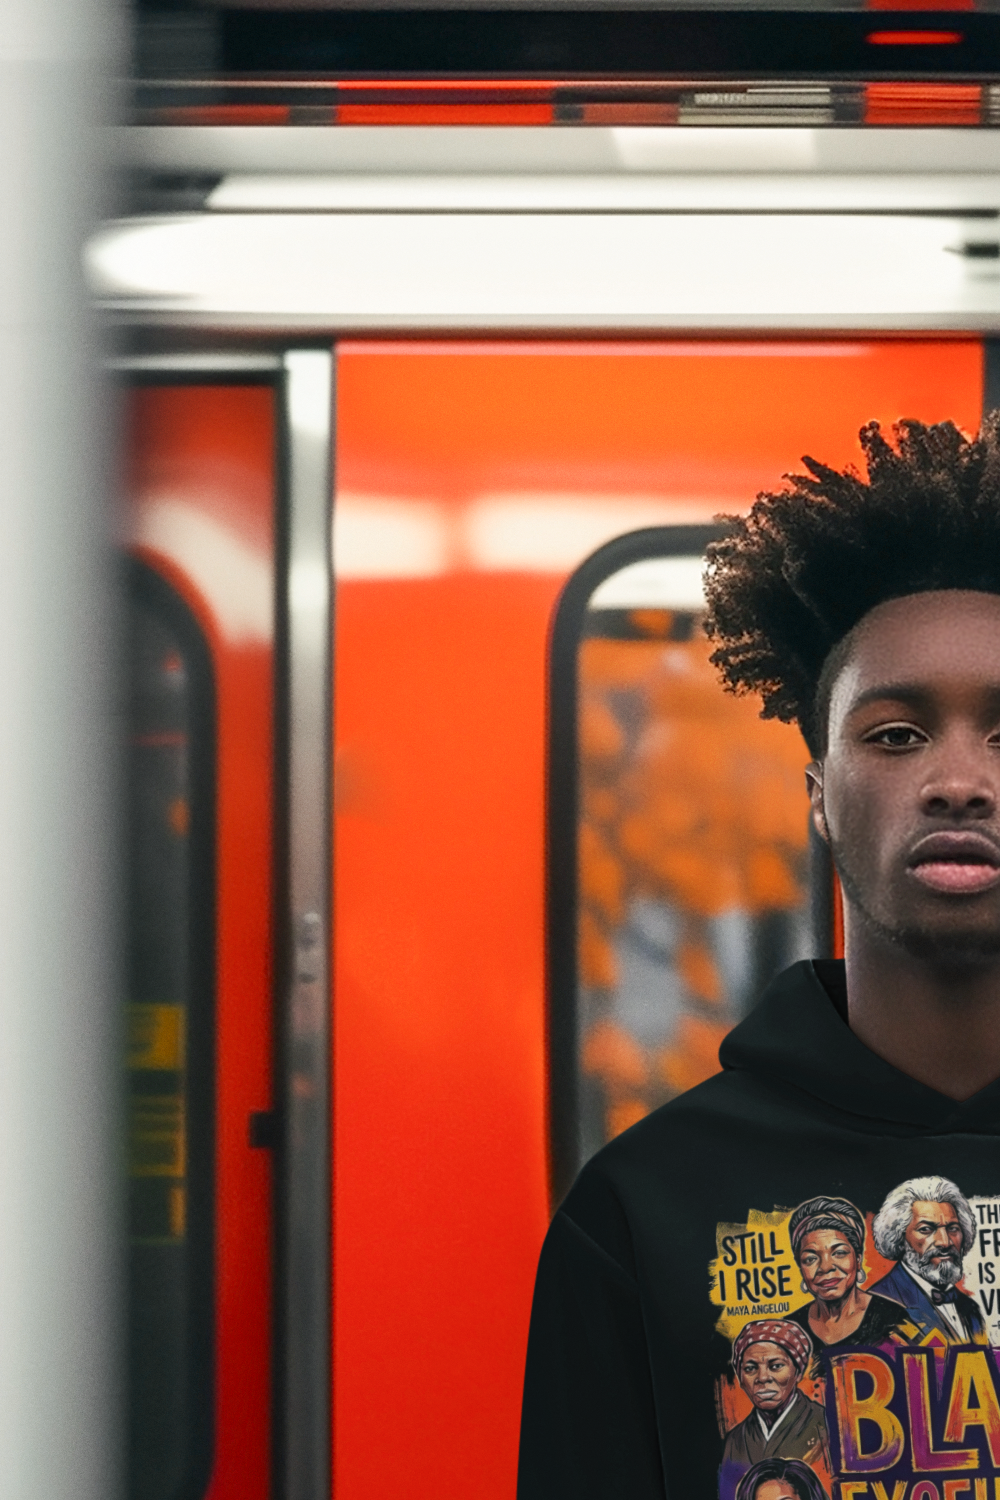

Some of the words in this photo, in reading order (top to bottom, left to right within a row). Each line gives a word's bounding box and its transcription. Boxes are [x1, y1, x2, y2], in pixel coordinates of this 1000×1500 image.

[722, 1232, 784, 1266] STILL
[719, 1270, 726, 1301] I
[736, 1265, 793, 1303] RISE
[978, 1262, 995, 1284] IS
[727, 1305, 750, 1316] MAYA
[751, 1302, 790, 1315] ANGELOU
